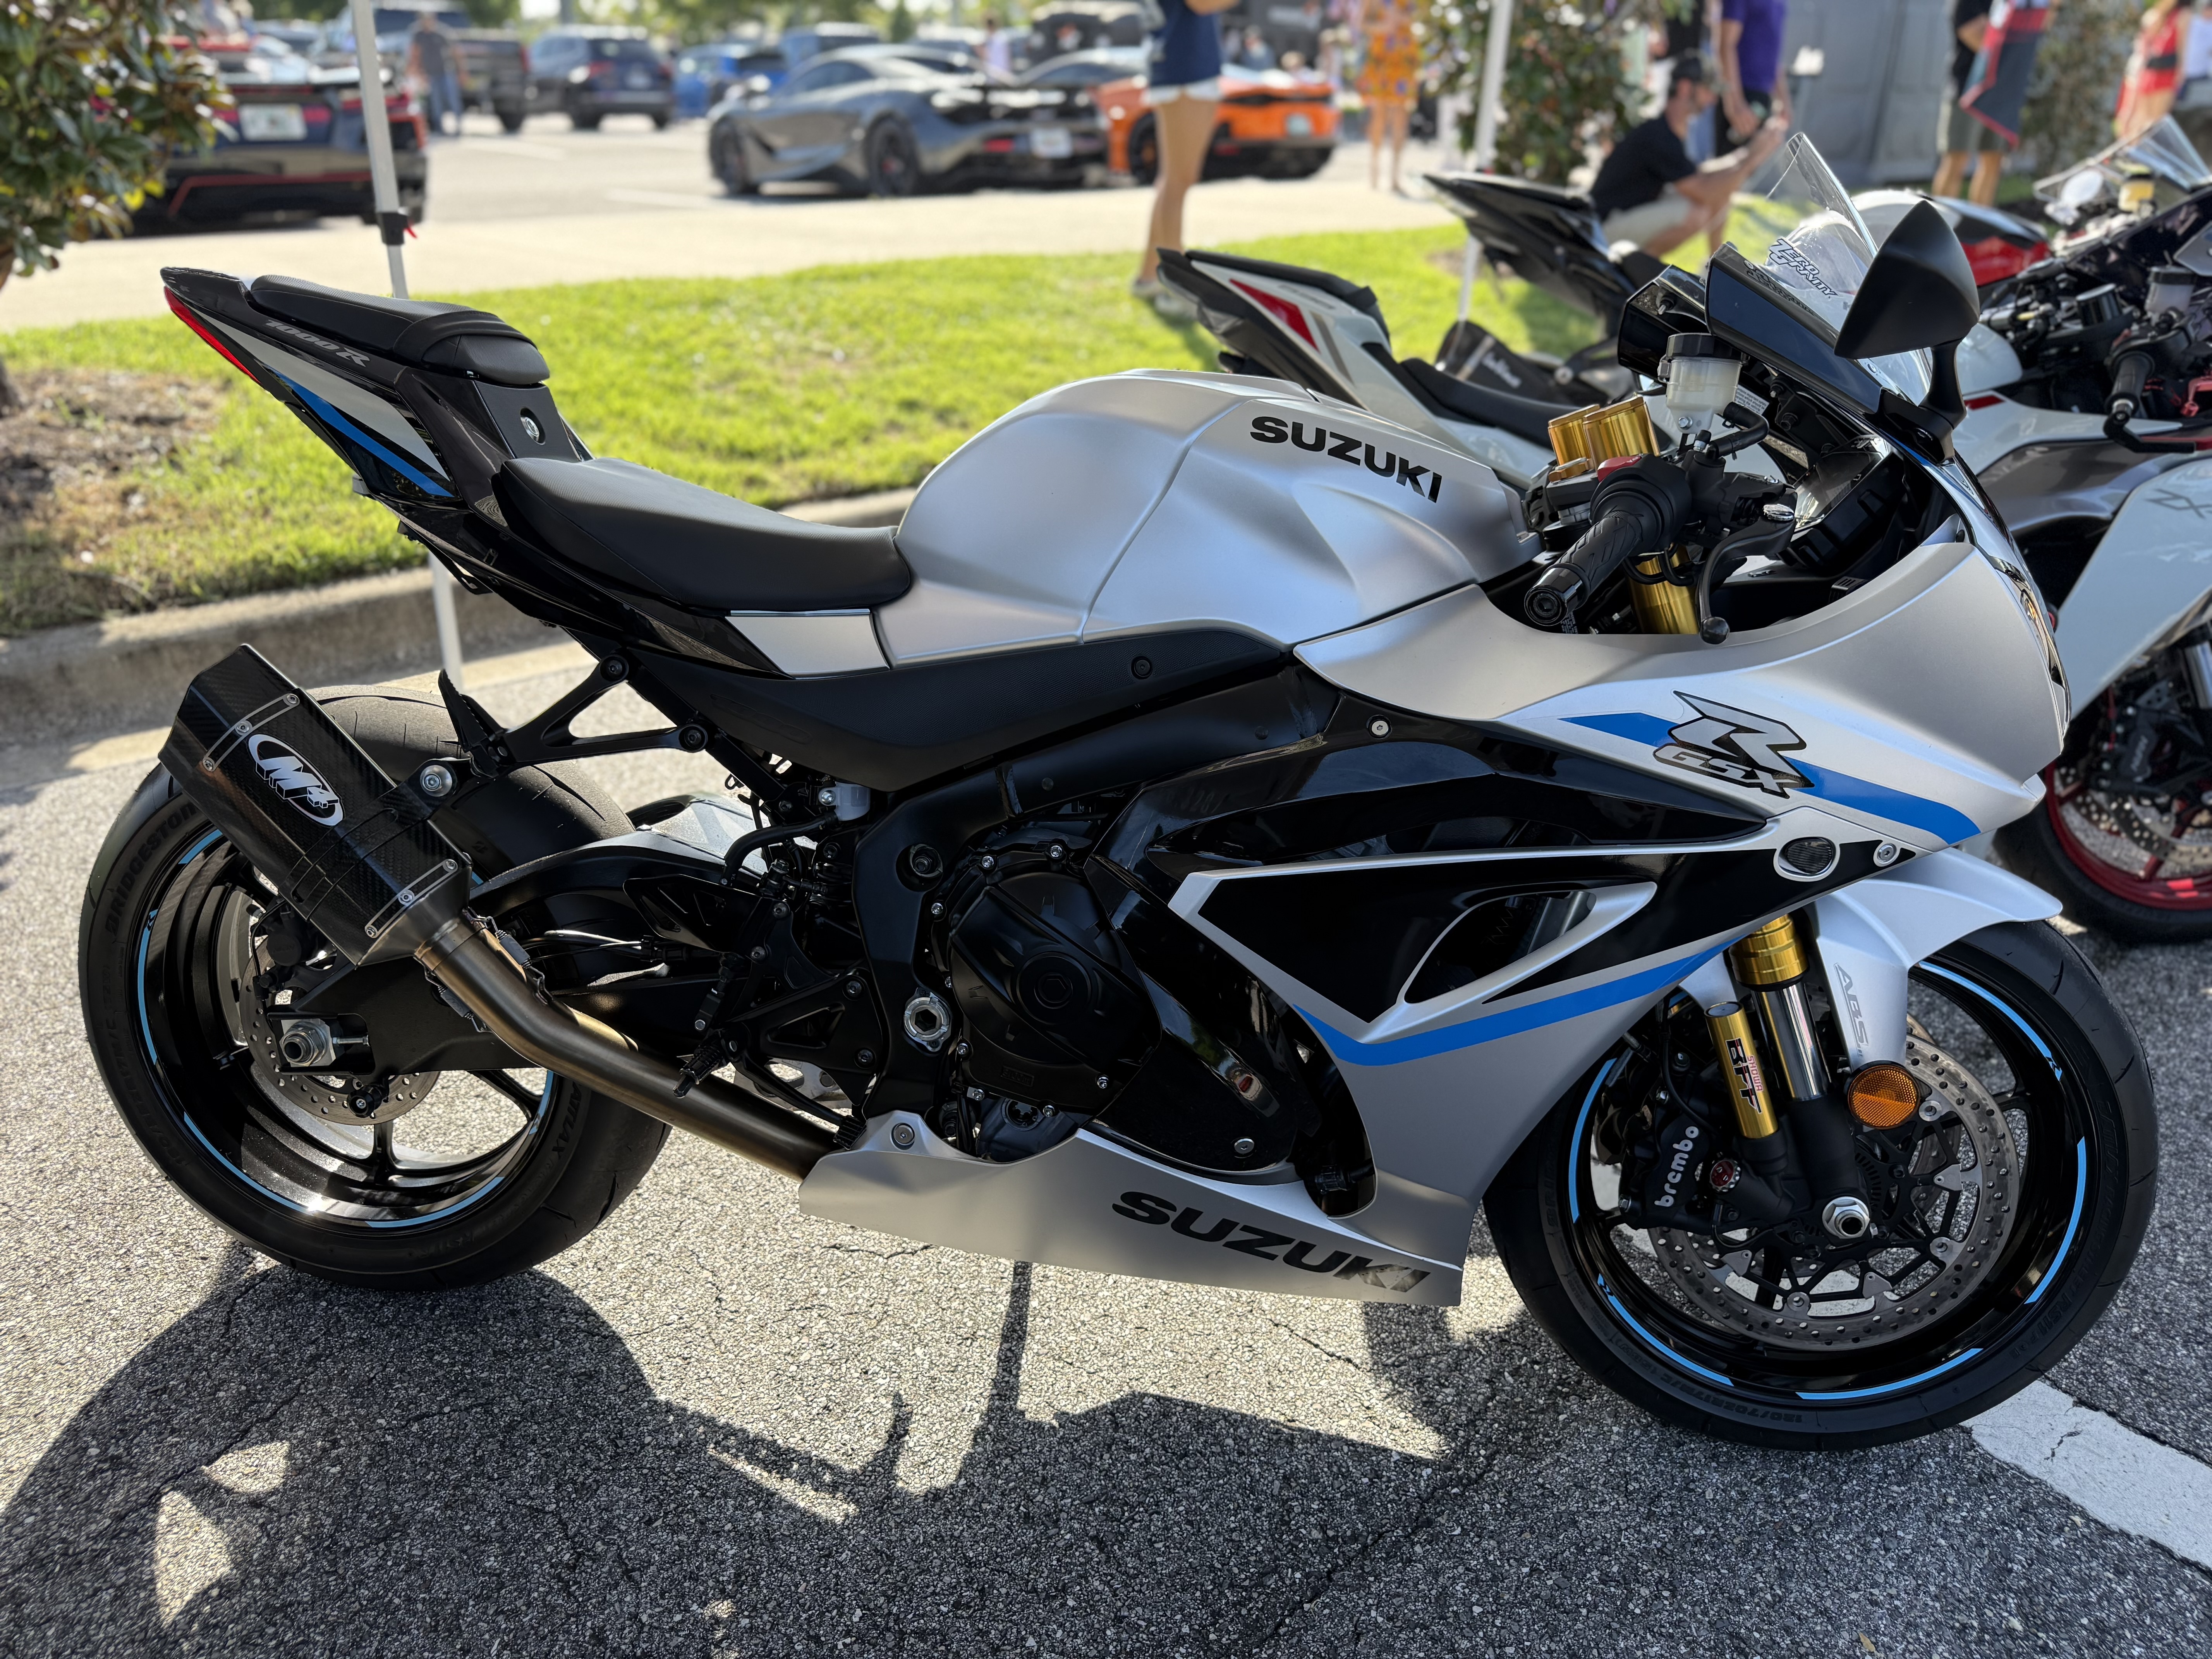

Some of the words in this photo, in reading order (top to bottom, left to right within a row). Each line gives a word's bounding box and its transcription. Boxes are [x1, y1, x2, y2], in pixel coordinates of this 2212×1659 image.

[1769, 239, 1819, 275] ZERO
[1769, 252, 1838, 295] GRAVITY
[266, 319, 339, 350] 1000
[336, 347, 370, 367] R
[1250, 416, 1442, 503] SUZUKI
[256, 756, 340, 809] M4
[1652, 743, 1800, 799] GSX
[105, 801, 198, 937] BRIDGESTON
[1725, 1037, 1762, 1114] BFF
[1747, 1055, 1764, 1091] SHOWA
[552, 1082, 582, 1158] ATTLAX
[1654, 1126, 1699, 1207] brembo
[1112, 1191, 1431, 1292] SUZUKI
